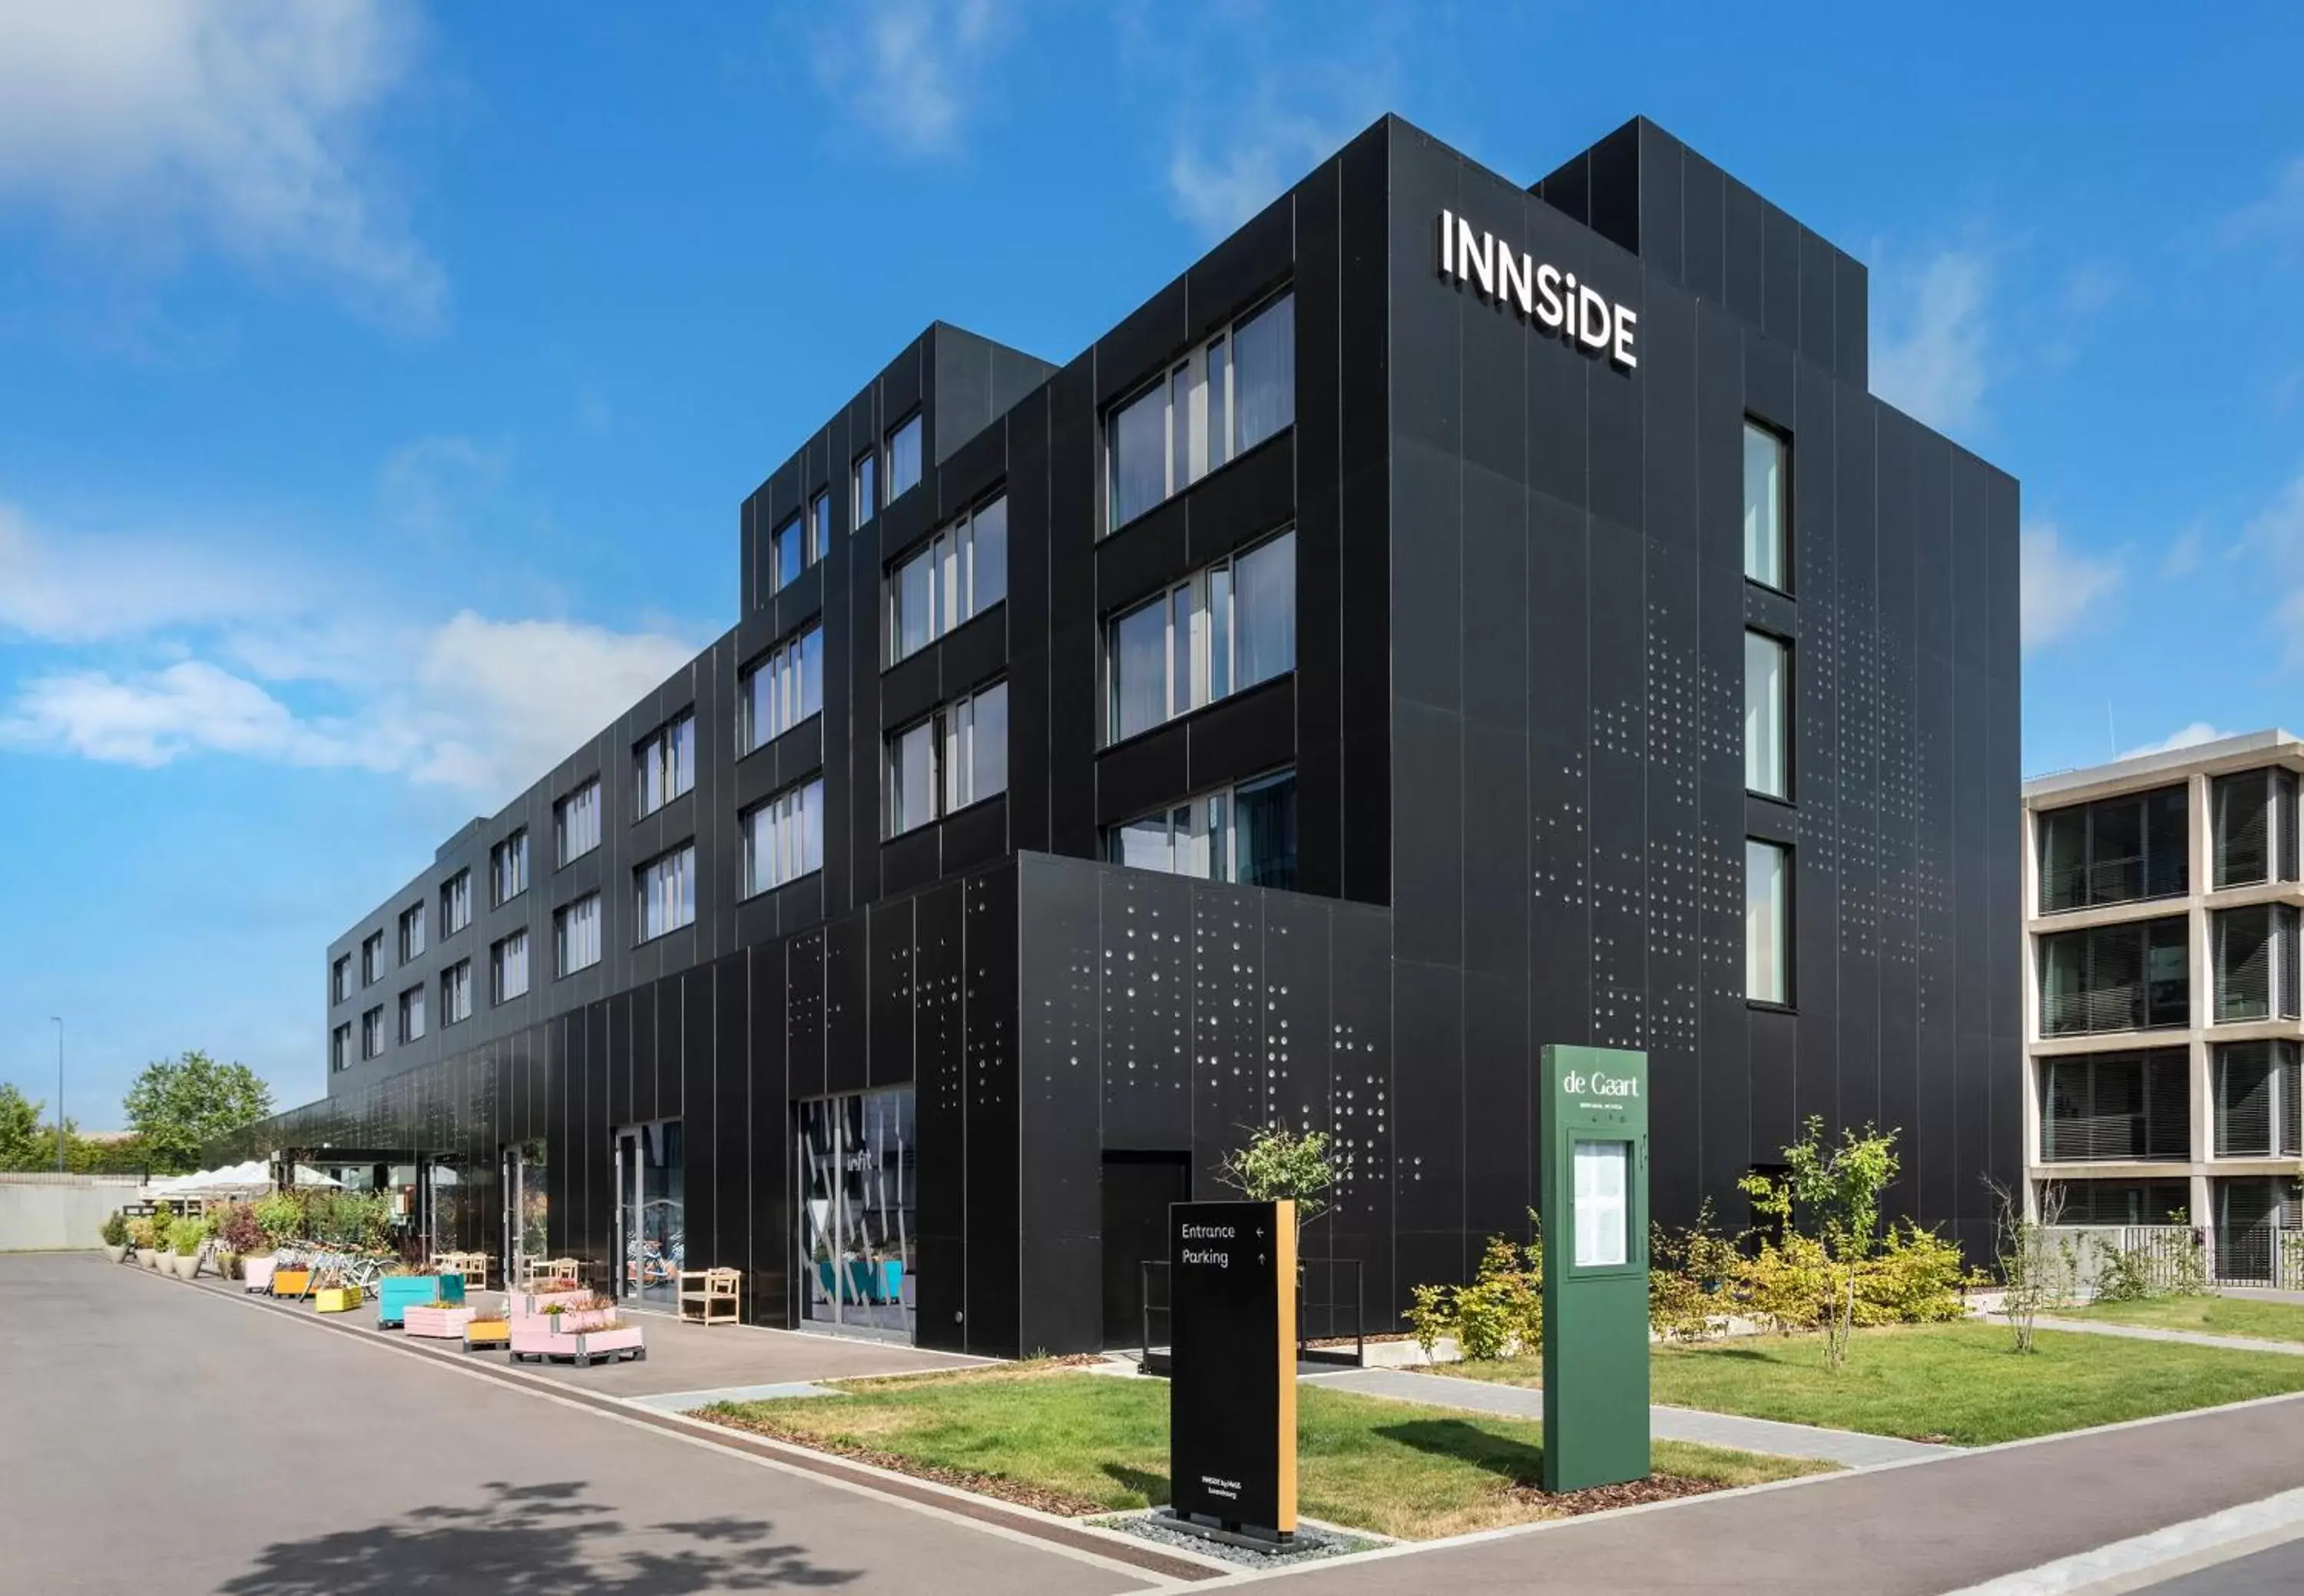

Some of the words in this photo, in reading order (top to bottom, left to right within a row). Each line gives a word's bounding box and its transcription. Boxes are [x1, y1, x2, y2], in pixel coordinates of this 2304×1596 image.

[1442, 208, 1637, 368] INNSiDE
[1563, 1070, 1586, 1094] de
[1591, 1071, 1640, 1098] Gaart
[1182, 1223, 1236, 1239] Entrance
[1182, 1248, 1229, 1269] Parking
